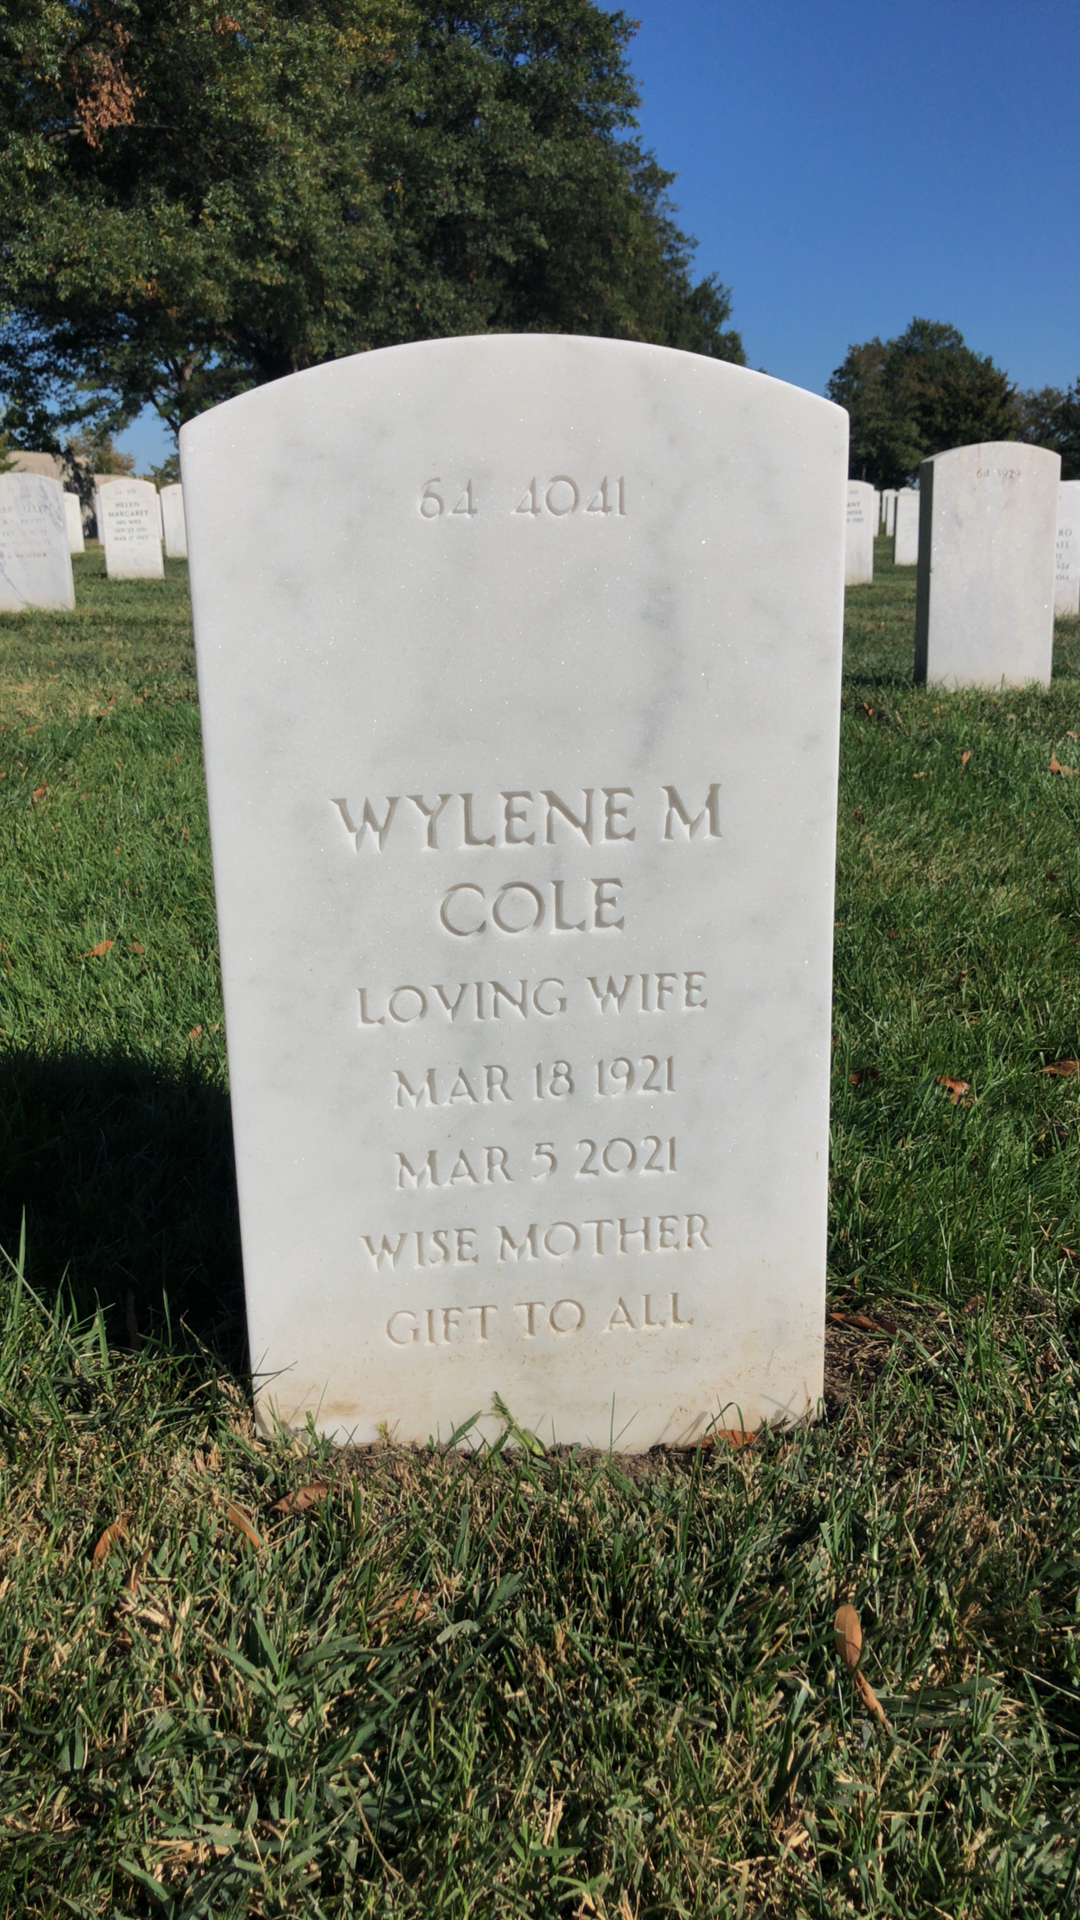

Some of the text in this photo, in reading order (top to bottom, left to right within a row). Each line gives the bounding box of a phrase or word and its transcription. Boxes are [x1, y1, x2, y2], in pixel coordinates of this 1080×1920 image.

[108, 510, 149, 518] MARGARET
[419, 475, 627, 518] 64 4041
[330, 783, 723, 852] WYLENE M
[440, 877, 625, 937] COLE
[356, 971, 708, 1027] LOVING WIFE
[393, 1054, 676, 1108] MAR 18 1921
[395, 1135, 678, 1190] MAR 5 2021
[360, 1213, 713, 1271] WISE MOTHER
[386, 1292, 694, 1345] GIFT TO ALL
